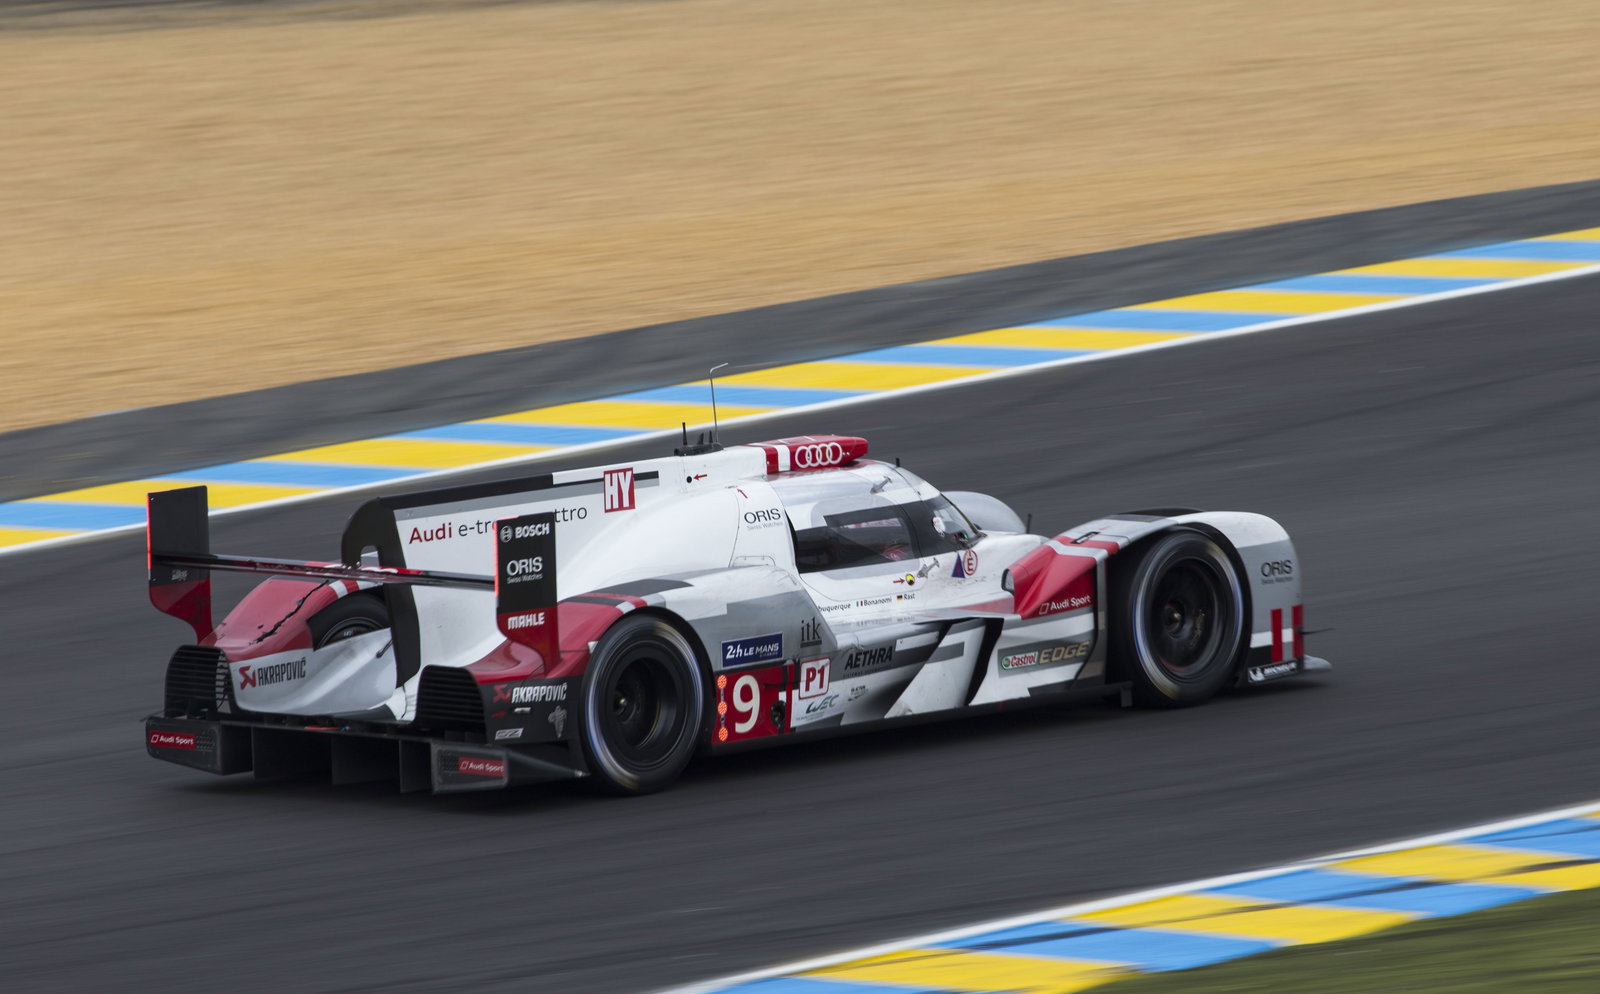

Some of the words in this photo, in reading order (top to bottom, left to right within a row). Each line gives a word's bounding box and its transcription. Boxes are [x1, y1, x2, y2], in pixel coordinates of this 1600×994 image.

[605, 471, 632, 510] HY
[743, 508, 781, 524] ORIS
[409, 523, 452, 544] Audi
[458, 519, 498, 537] e-tr
[515, 522, 550, 539] BOSCH
[506, 556, 543, 576] ORIS
[1260, 559, 1293, 577] ORIS
[1050, 599, 1069, 611] Audi
[1071, 595, 1091, 607] Sport
[507, 612, 545, 630] MAHLE
[801, 616, 821, 641] itk
[743, 646, 754, 656] LE
[755, 643, 779, 655] MANS
[845, 646, 893, 671] AETHRA
[1010, 653, 1037, 667] Castrol
[1039, 641, 1090, 664] EDGE
[805, 667, 825, 692] P1
[733, 675, 760, 733] 9
[805, 694, 839, 714] WEC
[159, 735, 175, 743] Audi
[176, 736, 194, 745] Sport
